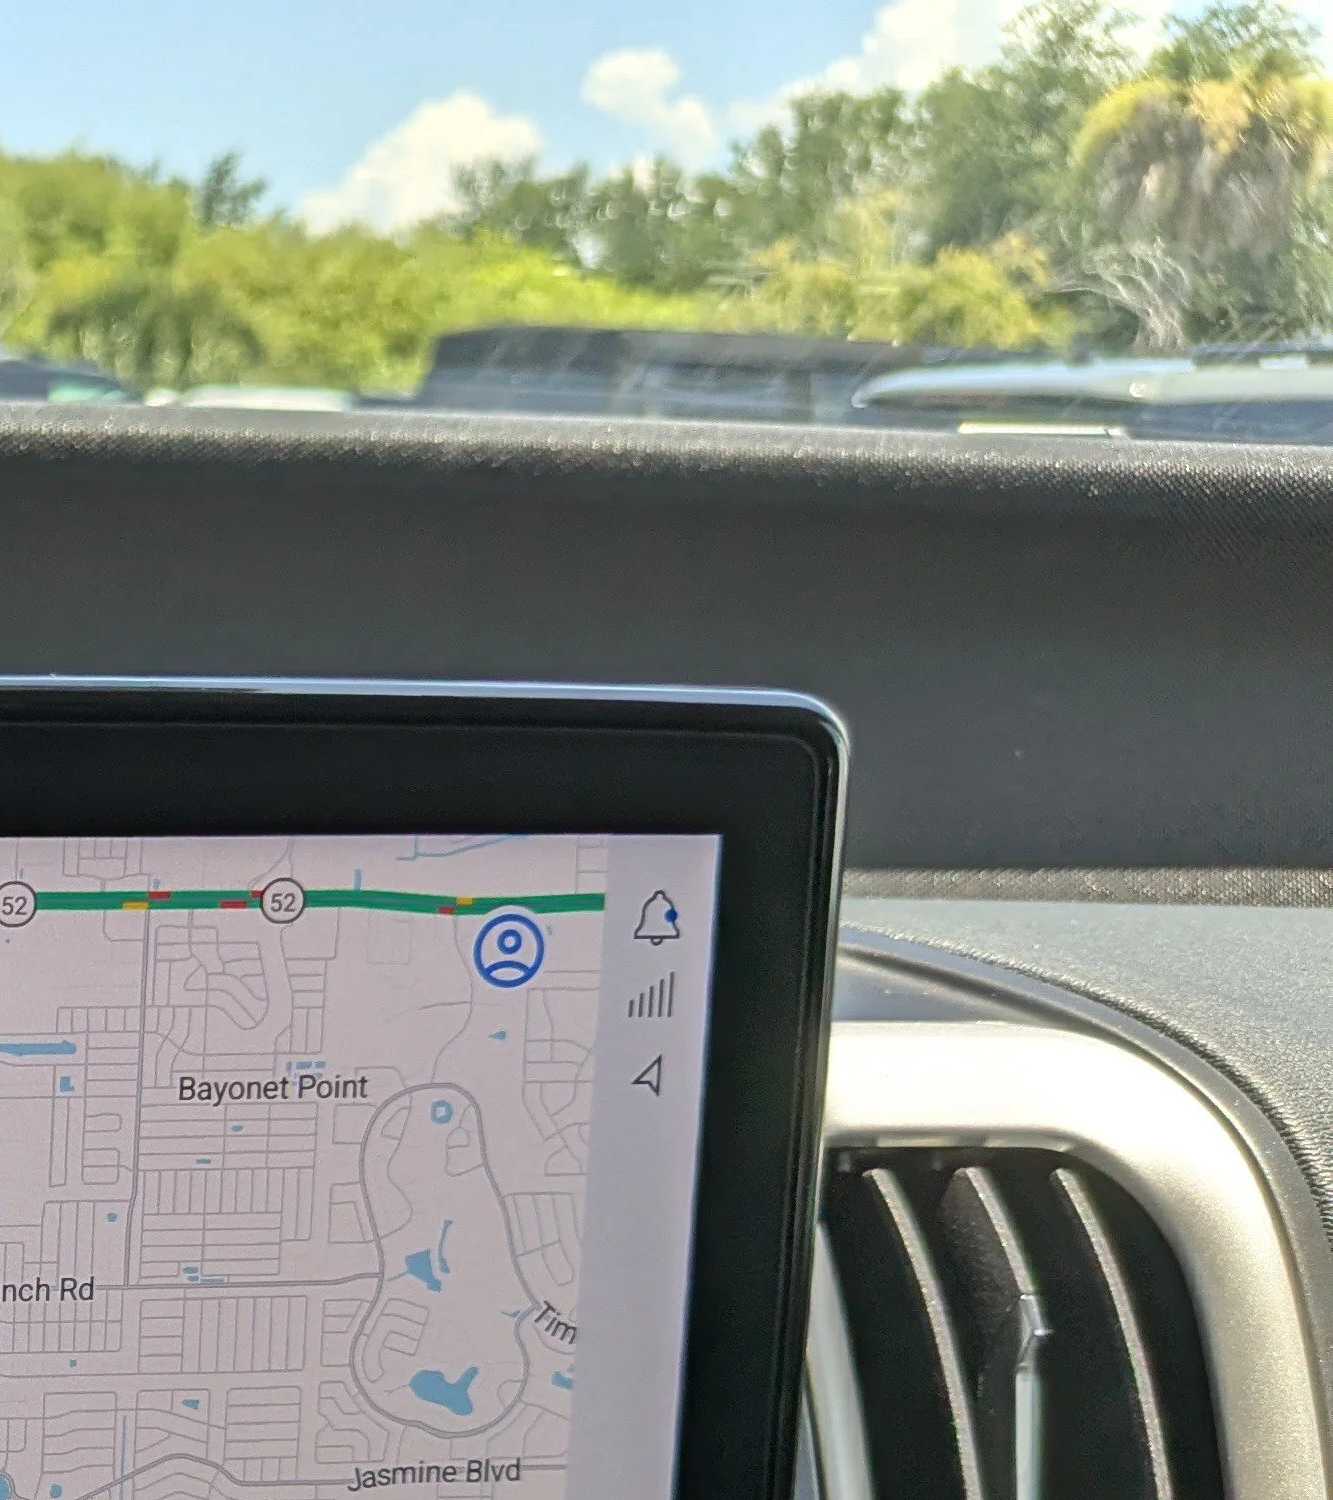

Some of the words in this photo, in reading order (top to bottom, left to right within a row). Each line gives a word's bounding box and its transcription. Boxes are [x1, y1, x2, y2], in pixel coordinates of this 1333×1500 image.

[1, 896, 28, 917] 52
[269, 892, 296, 913] 52
[177, 1076, 290, 1109] Bayonet
[297, 1074, 369, 1100] Point
[58, 1276, 96, 1302] Rd
[346, 1463, 457, 1492] Jasmine
[465, 1457, 522, 1484] Blvd
